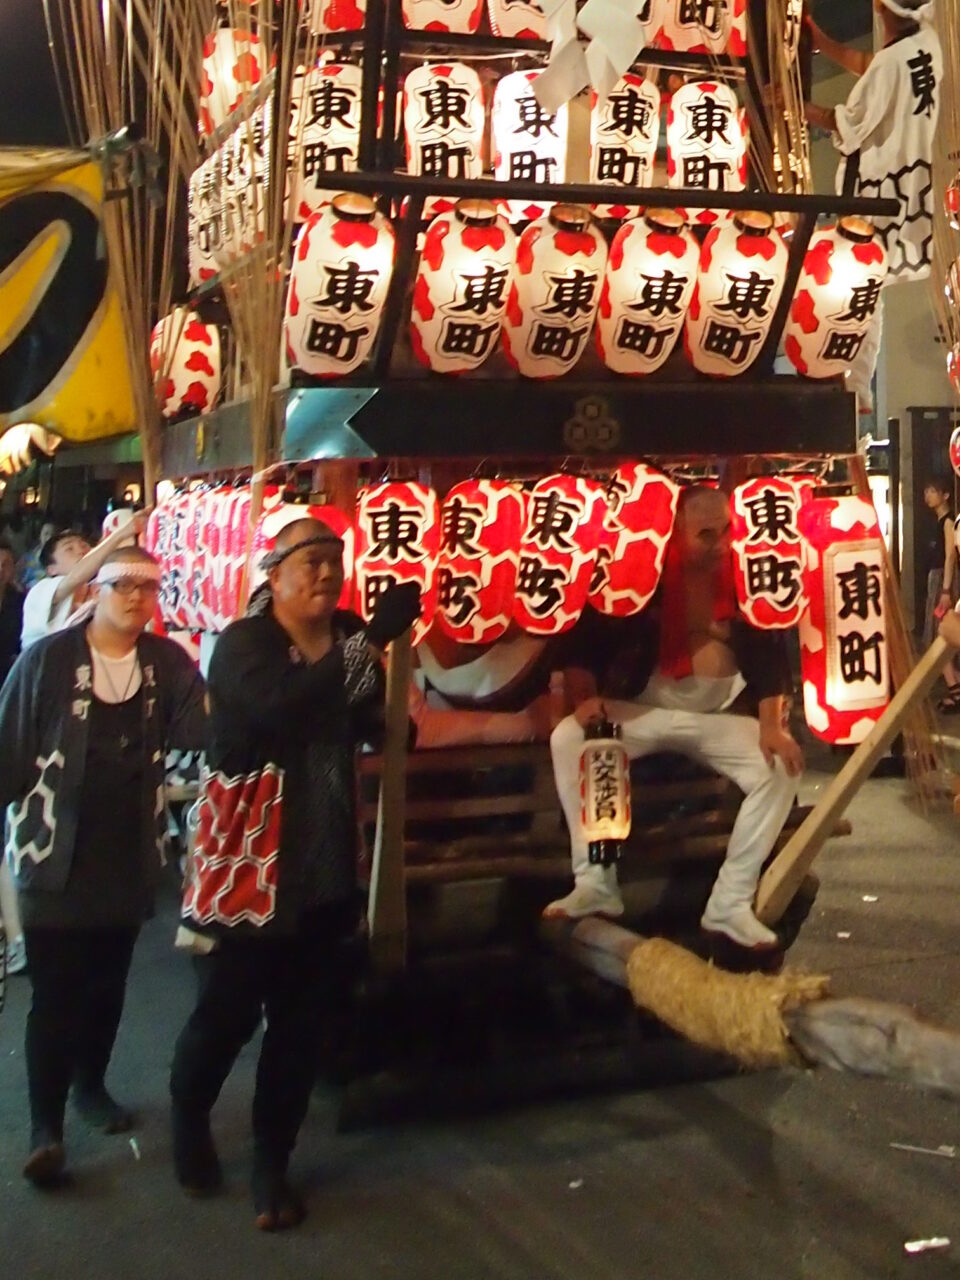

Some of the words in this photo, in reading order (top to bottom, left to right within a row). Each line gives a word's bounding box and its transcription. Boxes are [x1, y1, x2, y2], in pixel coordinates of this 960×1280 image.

[304, 79, 356, 175] 東町
[419, 80, 471, 179] 東町
[907, 49, 936, 119] 東
[509, 95, 558, 184] 東町
[596, 87, 653, 187] 東町
[683, 96, 733, 189] 東町
[308, 261, 379, 360] 東町
[442, 265, 508, 358] 東町
[532, 268, 601, 363] 東町
[617, 268, 691, 358] 東町
[705, 270, 772, 361] 東町
[823, 279, 881, 361] 東町
[438, 498, 486, 622] 東町
[517, 489, 581, 614] 東町
[744, 489, 801, 607] 東町
[836, 562, 882, 684] 東町
